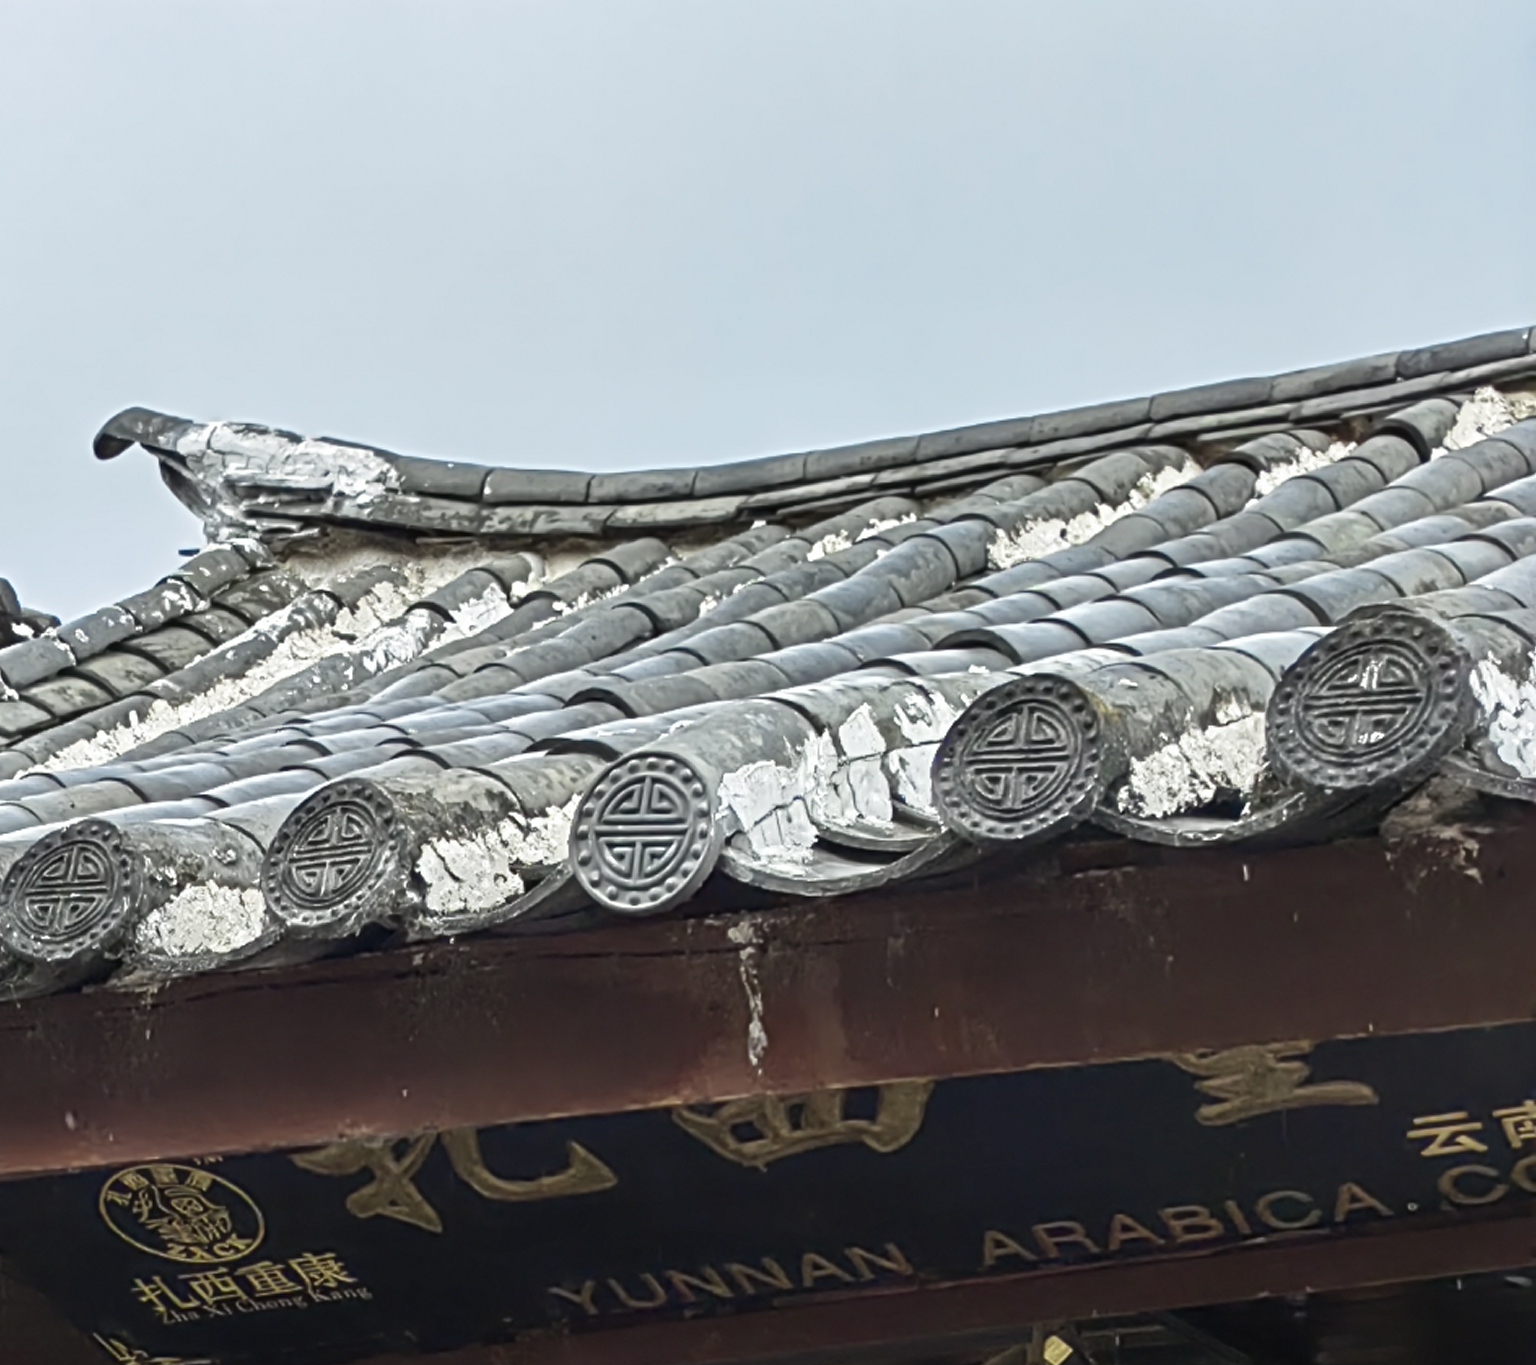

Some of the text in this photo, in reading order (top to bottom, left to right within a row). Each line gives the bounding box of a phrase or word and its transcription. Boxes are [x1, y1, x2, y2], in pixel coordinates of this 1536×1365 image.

[131, 1251, 359, 1315] 扎西重康
[550, 1242, 913, 1314] YUNNAN
